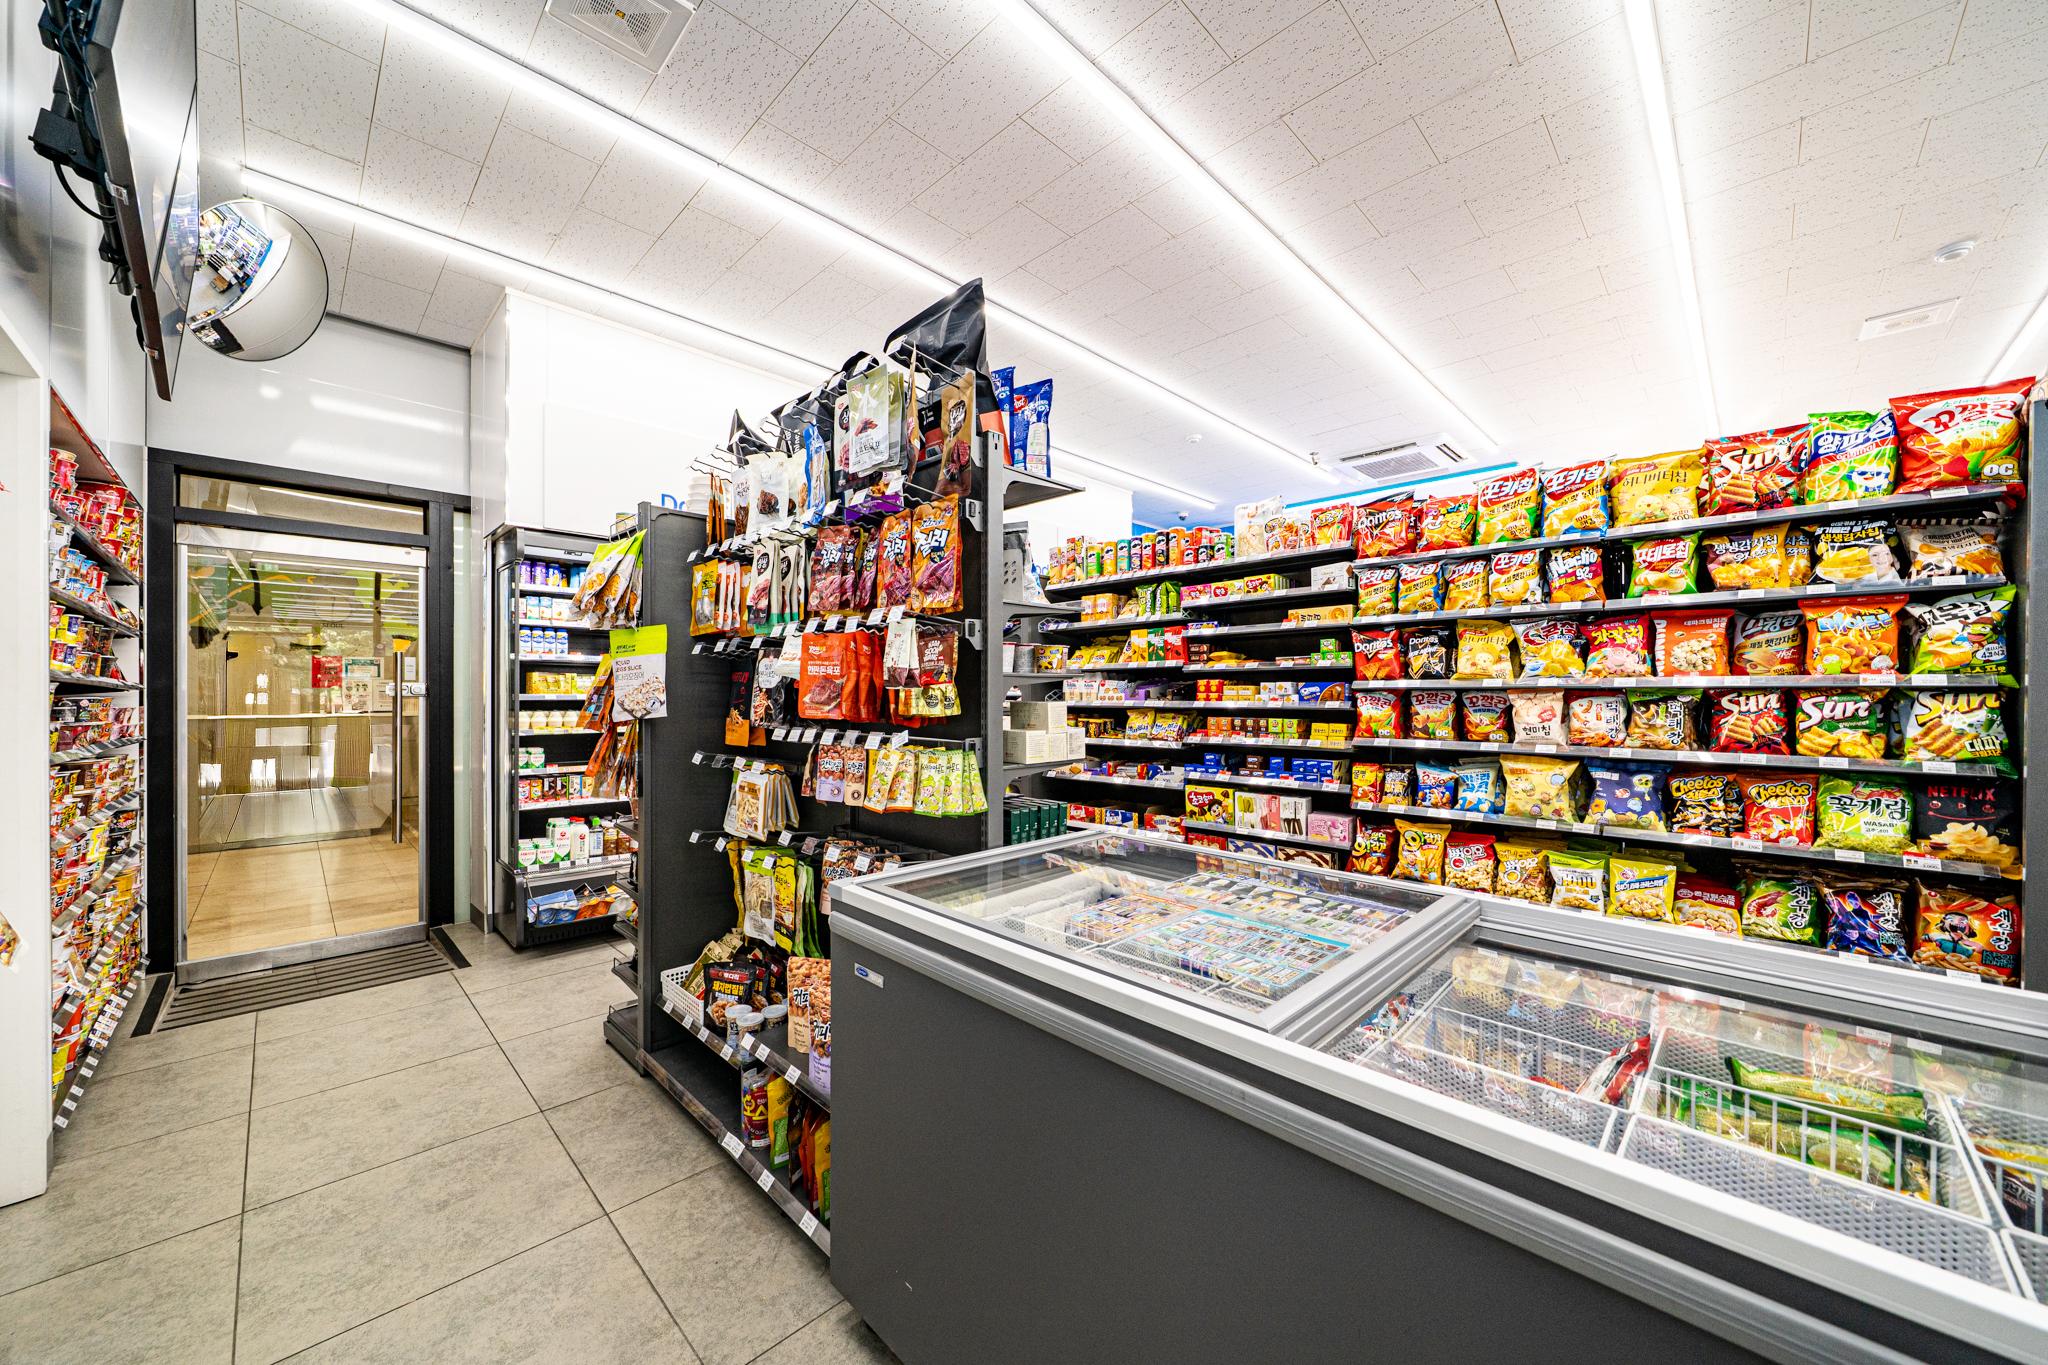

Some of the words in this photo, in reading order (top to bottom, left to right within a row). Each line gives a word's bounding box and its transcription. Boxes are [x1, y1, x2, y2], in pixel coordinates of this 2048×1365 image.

[1818, 417, 1894, 453] 양파링
[1546, 465, 1603, 491] 포카칩
[1983, 463, 2014, 476] OC
[1484, 477, 1533, 501] 포카칩
[883, 540, 907, 561] 질러
[914, 528, 949, 558] 질러
[1496, 553, 1534, 572] 포카칩
[1549, 549, 1599, 577] Nacho
[1634, 542, 1690, 569] 포테토칩
[1361, 570, 1394, 586] 포카칩
[1355, 637, 1393, 653] Doritos
[1409, 636, 1439, 645] Doritos
[1592, 625, 1644, 644] 자갈치
[1412, 692, 1453, 705] 꼬깔콘
[1467, 694, 1509, 708] 꼬깔콘
[1720, 692, 1781, 724] Sun
[1915, 691, 2001, 727] Sun
[1799, 696, 1871, 731] Sun
[1522, 725, 1551, 736] 현미칩
[1671, 776, 1726, 798] Cheetos
[1749, 782, 1811, 804] Cheetos
[1927, 785, 1996, 801] NETFLIX
[1828, 795, 1911, 822] 꽃게랑
[1788, 886, 1811, 928] 새우깡
